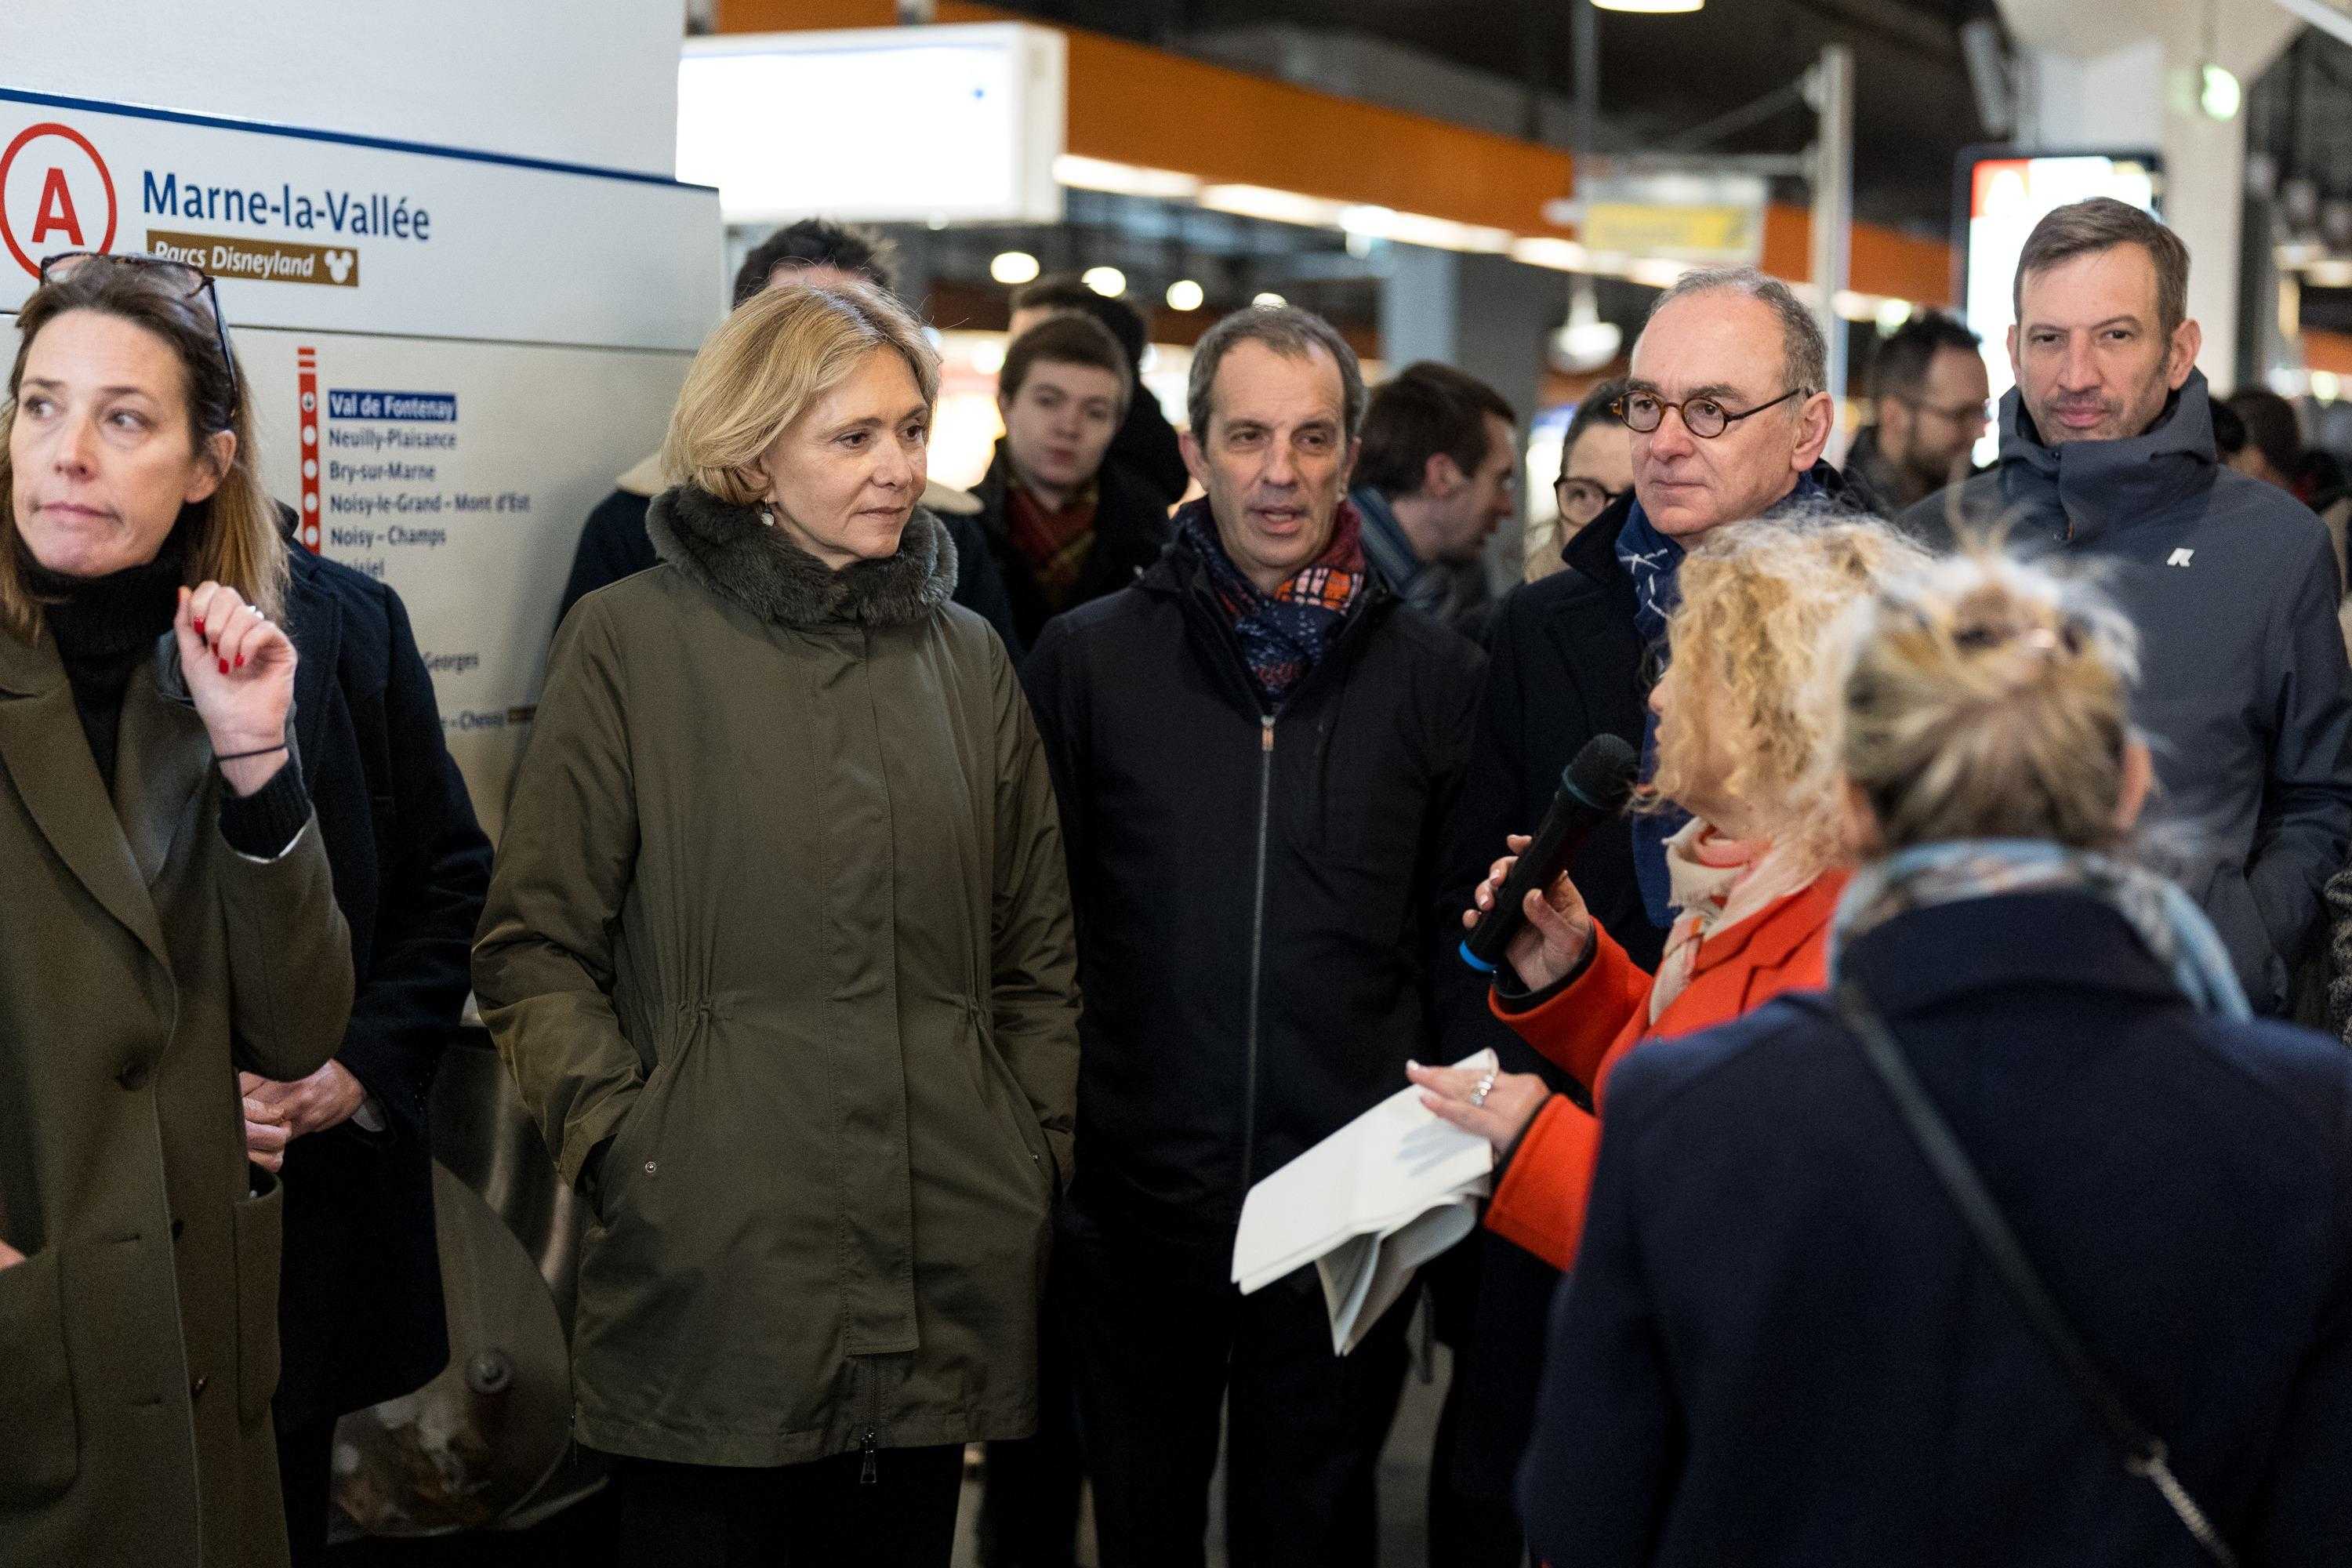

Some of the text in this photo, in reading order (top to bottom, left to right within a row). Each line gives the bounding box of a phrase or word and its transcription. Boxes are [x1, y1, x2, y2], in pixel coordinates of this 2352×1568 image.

[31, 168, 85, 245] A
[143, 169, 430, 240] Marne-la-Vallée
[212, 245, 316, 278] Disneyland
[331, 393, 454, 421] Val de Fontenay
[328, 429, 457, 451] Neuilly-Plaisance
[329, 461, 436, 483] Bry-sur-Marne
[330, 494, 441, 517] Noisy-le-Grand
[330, 526, 374, 548] Noisy
[387, 526, 446, 547] Champs
